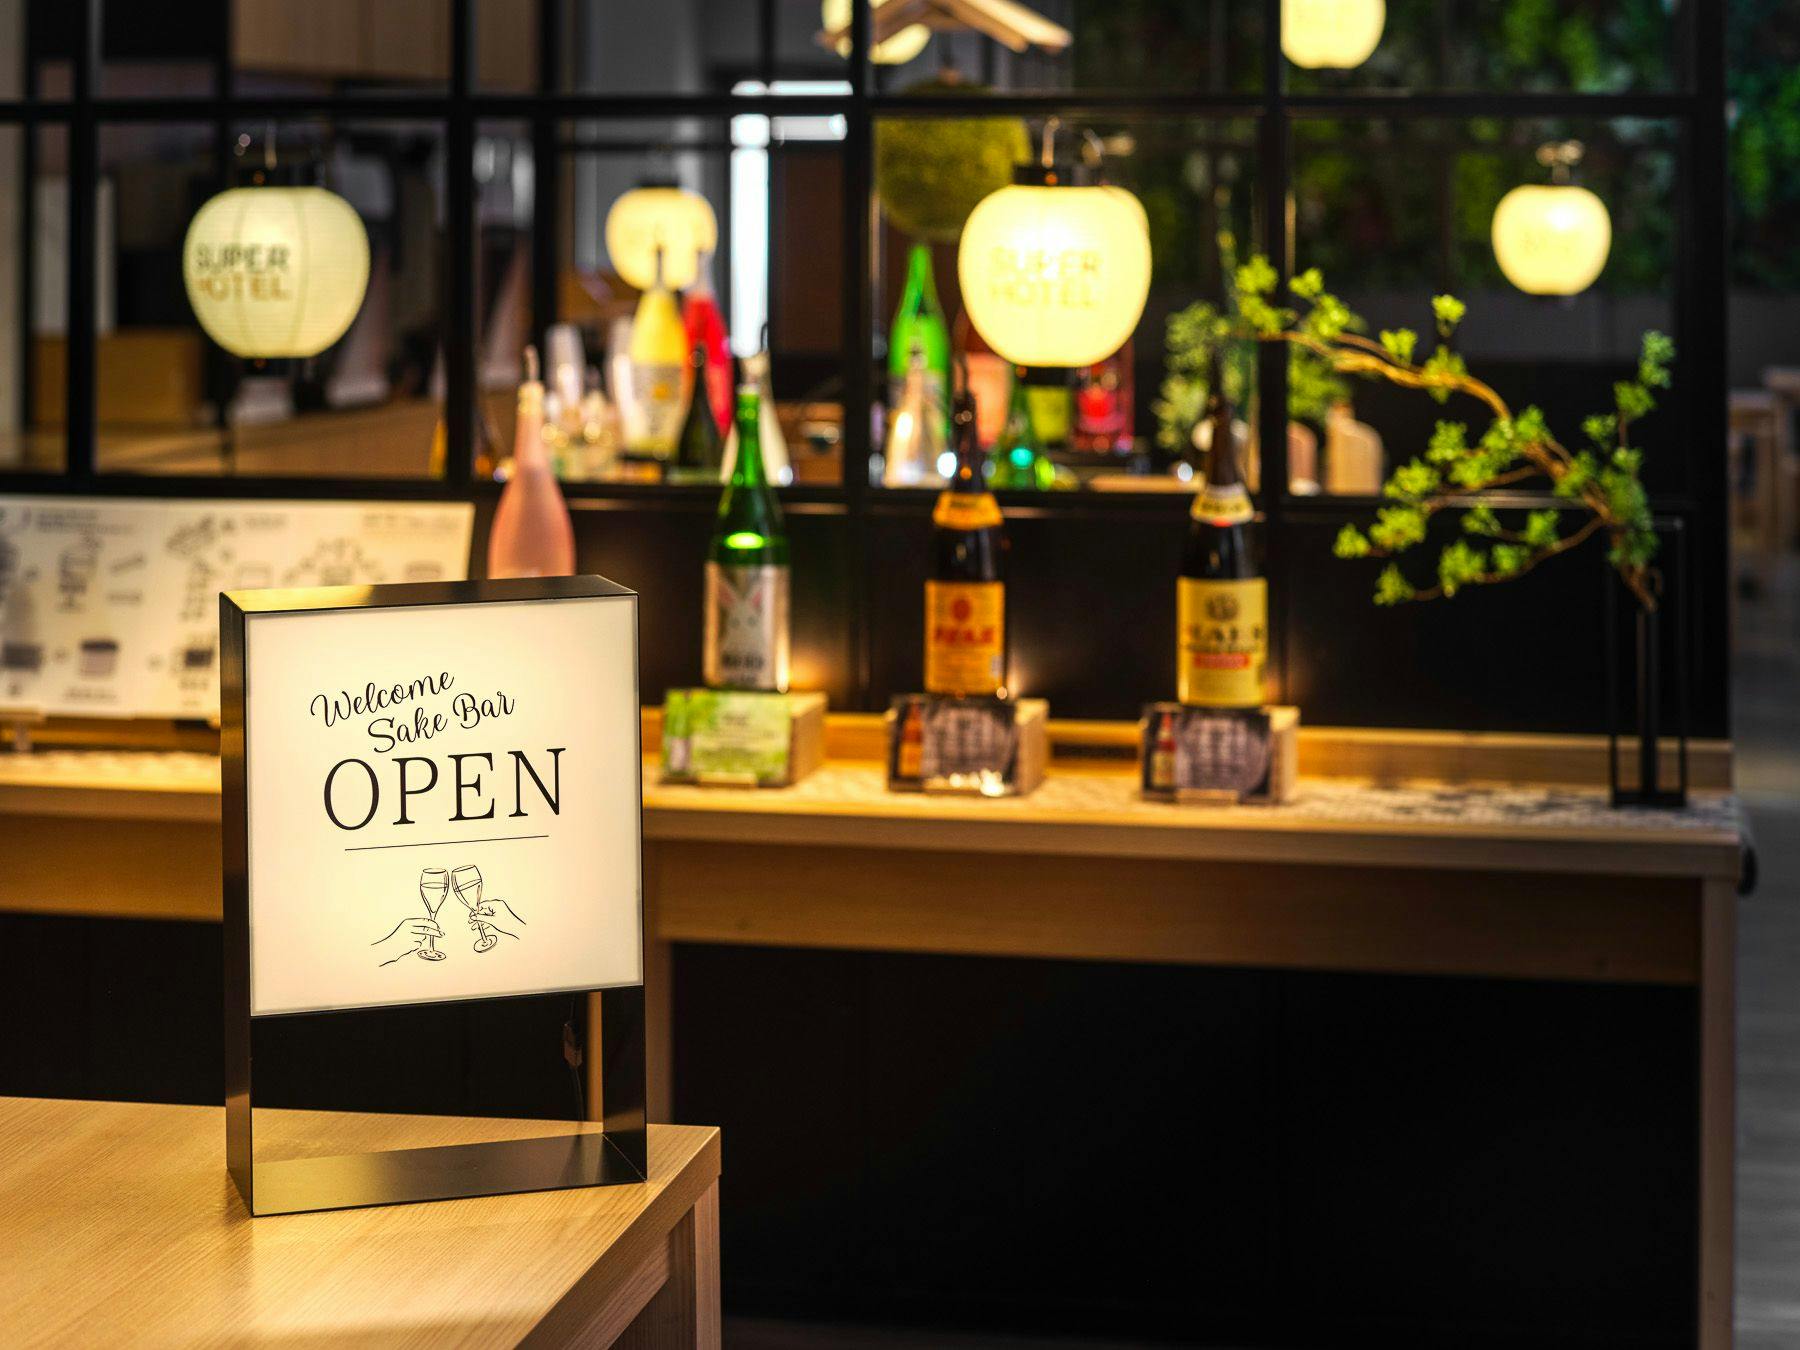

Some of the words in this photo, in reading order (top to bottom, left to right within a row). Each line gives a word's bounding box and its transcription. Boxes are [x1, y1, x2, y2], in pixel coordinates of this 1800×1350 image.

[195, 243, 290, 272] SUPER
[310, 671, 455, 728] Welcome
[367, 707, 449, 753] Sake
[452, 690, 515, 730] Bar
[323, 747, 567, 831] OPEN
